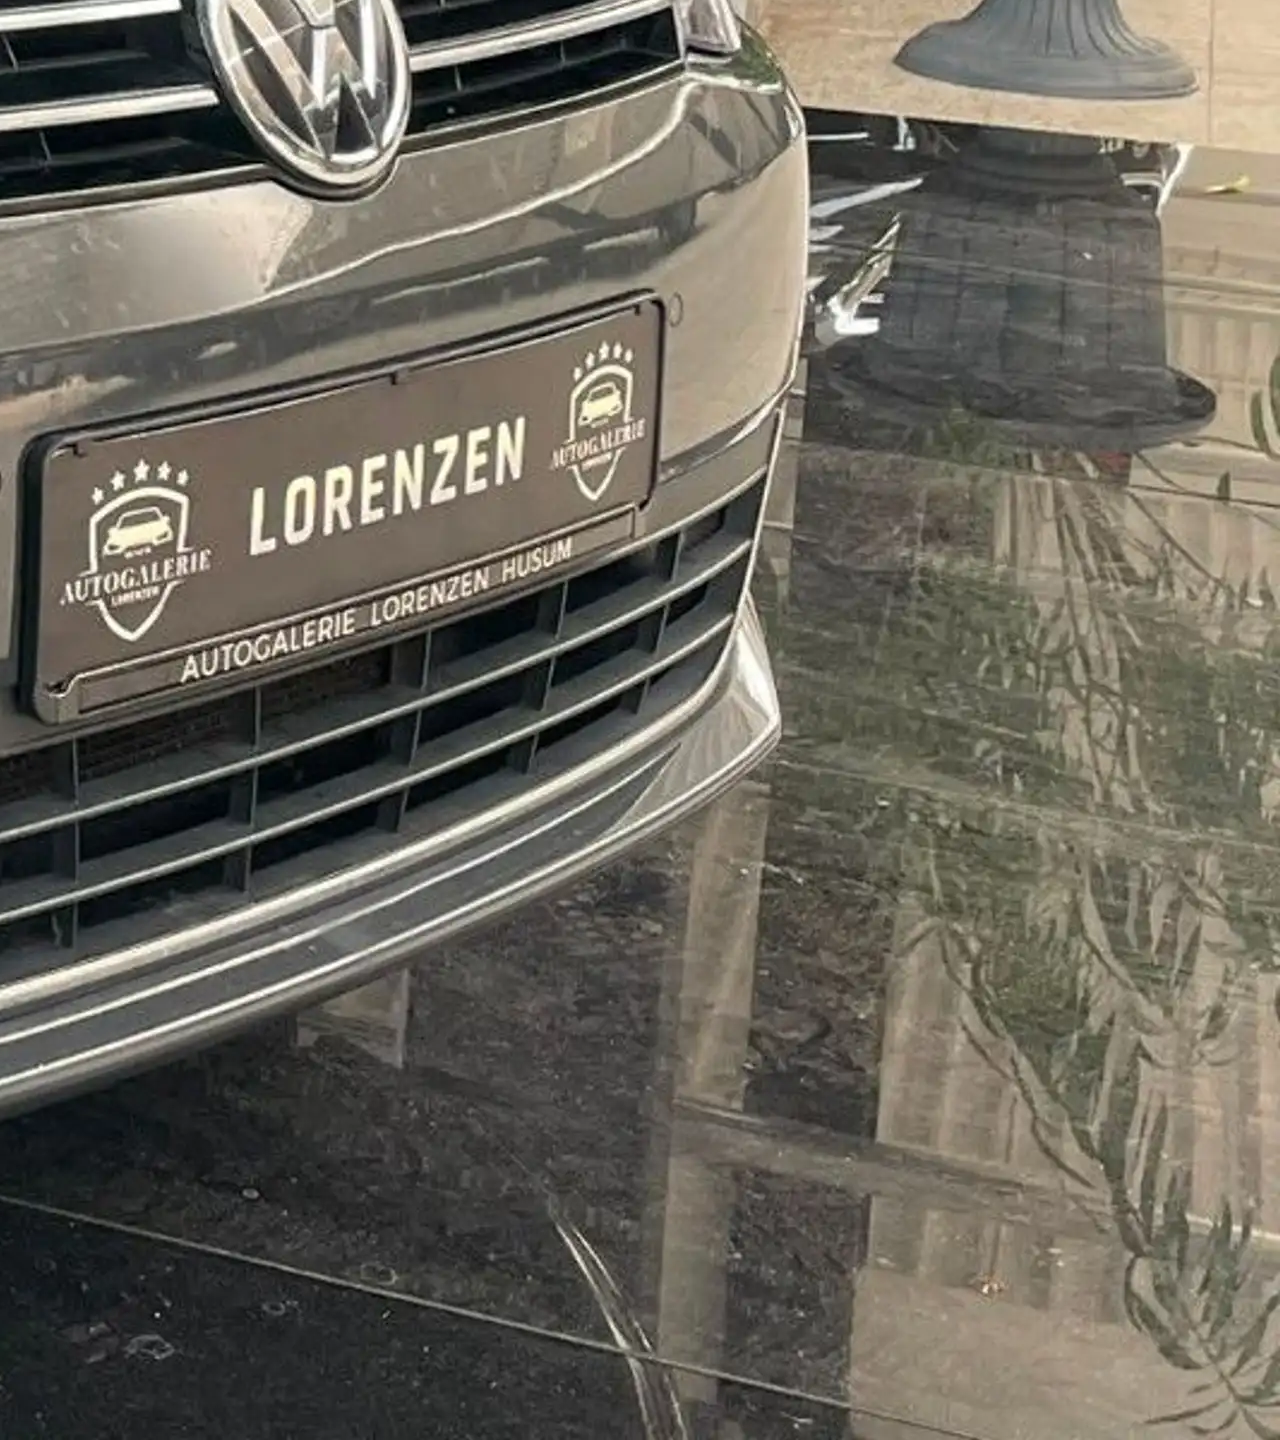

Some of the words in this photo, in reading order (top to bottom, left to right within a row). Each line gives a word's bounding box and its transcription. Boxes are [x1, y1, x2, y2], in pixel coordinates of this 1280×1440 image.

[248, 415, 526, 555] LORENZEN
[60, 548, 212, 606] AUTOGALERIE
[181, 612, 356, 683] AUTOGALERIE
[370, 567, 490, 626] LORENZEN
[502, 538, 573, 583] HUSUM
